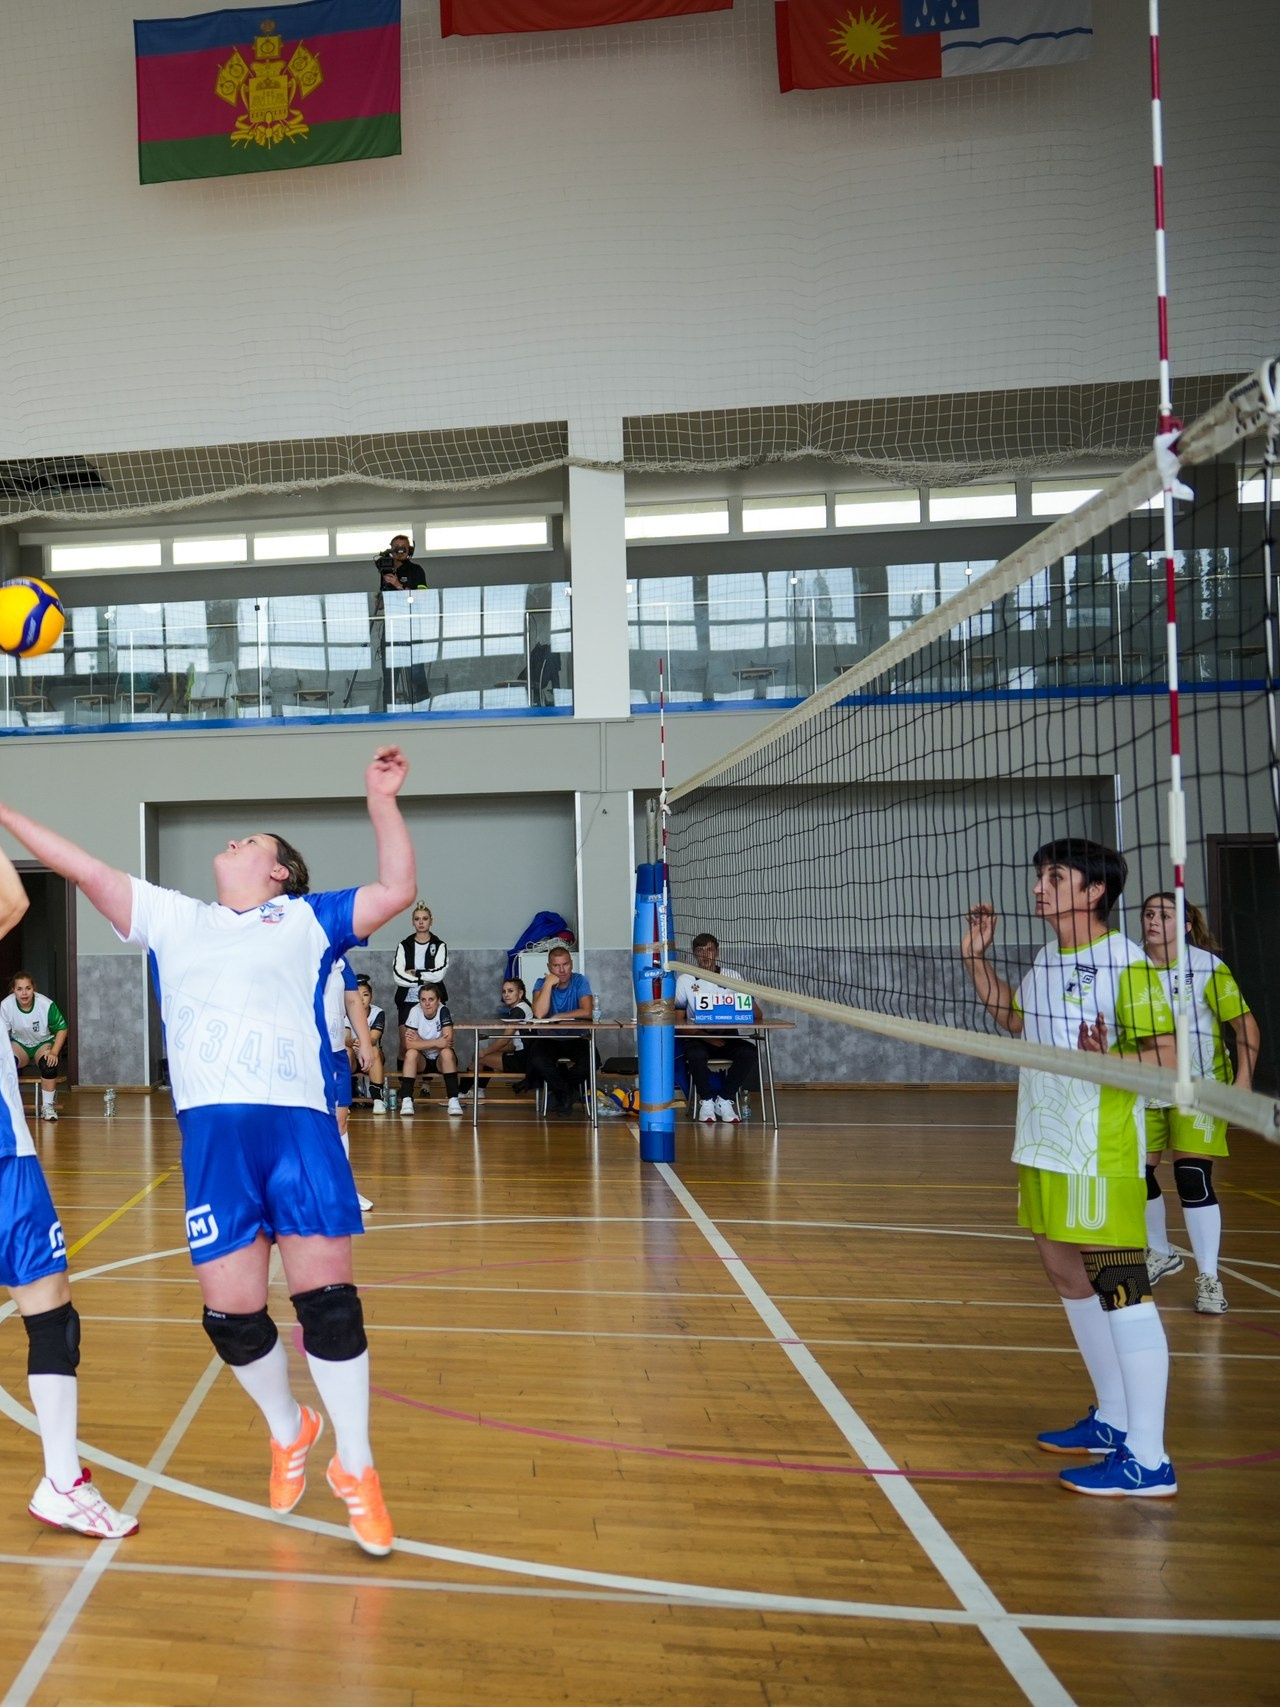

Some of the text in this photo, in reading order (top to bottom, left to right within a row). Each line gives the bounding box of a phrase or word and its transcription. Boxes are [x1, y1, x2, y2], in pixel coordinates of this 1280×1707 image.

[700, 996, 709, 1010] 5
[737, 996, 751, 1009] 14
[200, 1019, 228, 1063] 3
[237, 1030, 262, 1075] 4
[277, 1037, 297, 1082] 5
[1193, 1111, 1215, 1143] 4
[1066, 1173, 1107, 1230] 10
